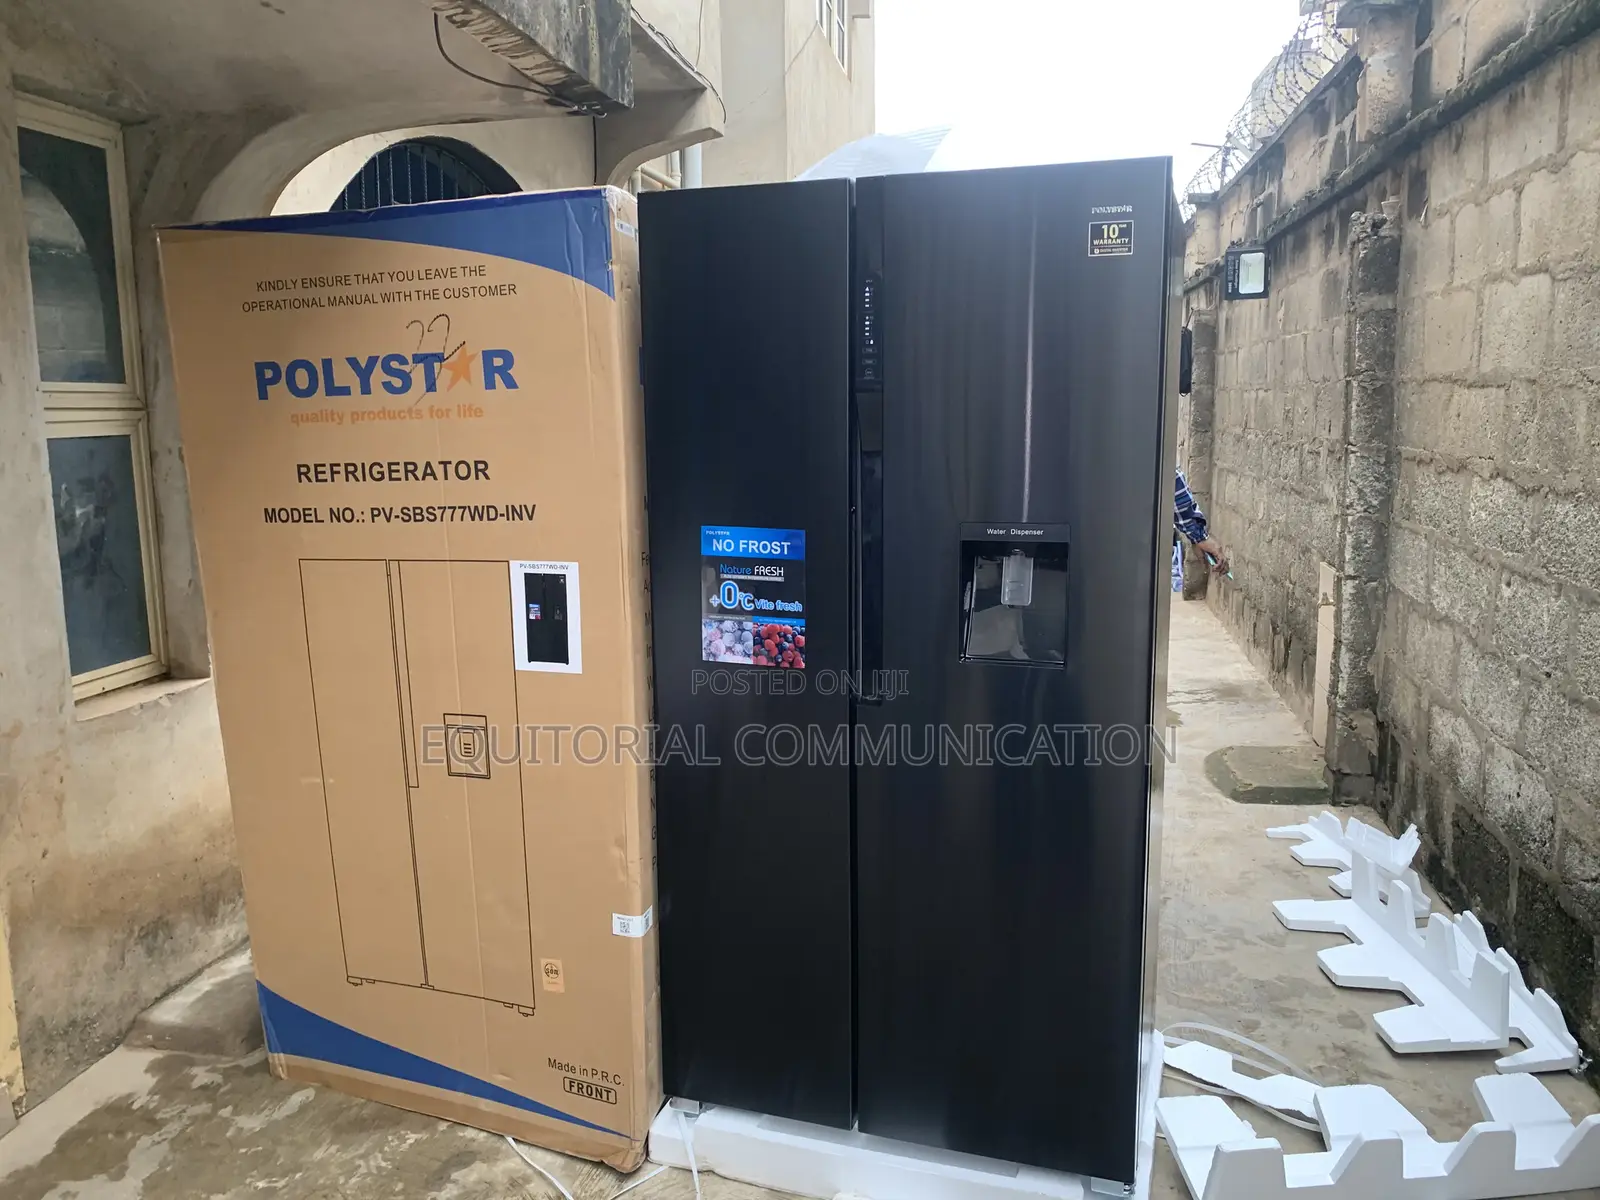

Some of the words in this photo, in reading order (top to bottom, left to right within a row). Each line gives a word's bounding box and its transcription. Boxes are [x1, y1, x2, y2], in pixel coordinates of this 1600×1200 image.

[1101, 224, 1119, 239] 10
[1093, 238, 1129, 246] WARRANTY
[256, 279, 298, 293] KINDLY
[301, 274, 352, 289] ENSURE
[354, 272, 385, 286] THAT
[387, 270, 415, 283] YOU
[418, 267, 458, 281] LEAVE
[460, 265, 486, 278] THE
[242, 298, 326, 313] OPERATIONAL
[327, 293, 379, 308] MANUAL
[379, 291, 412, 304] WITH
[414, 288, 440, 301] THE
[442, 284, 517, 300] CUSTOMER
[290, 406, 345, 426] quality
[350, 404, 424, 422] products
[428, 403, 452, 419] for
[456, 402, 484, 419] life
[296, 460, 491, 483] REFRIGERATOR
[263, 507, 325, 524] MODEL
[329, 506, 365, 523] NO.:
[371, 504, 537, 523] PV-SBS777WD-INV
[1010, 528, 1044, 536] Dispenser
[712, 539, 735, 552] NO
[739, 540, 791, 555] FROST
[720, 564, 752, 575] Nature
[754, 565, 784, 577] FRESH
[775, 600, 803, 612] fresh
[547, 1057, 577, 1074] Made
[579, 1065, 589, 1077] in
[591, 1068, 625, 1087] P.R.C.
[568, 1080, 612, 1101] FRONT
